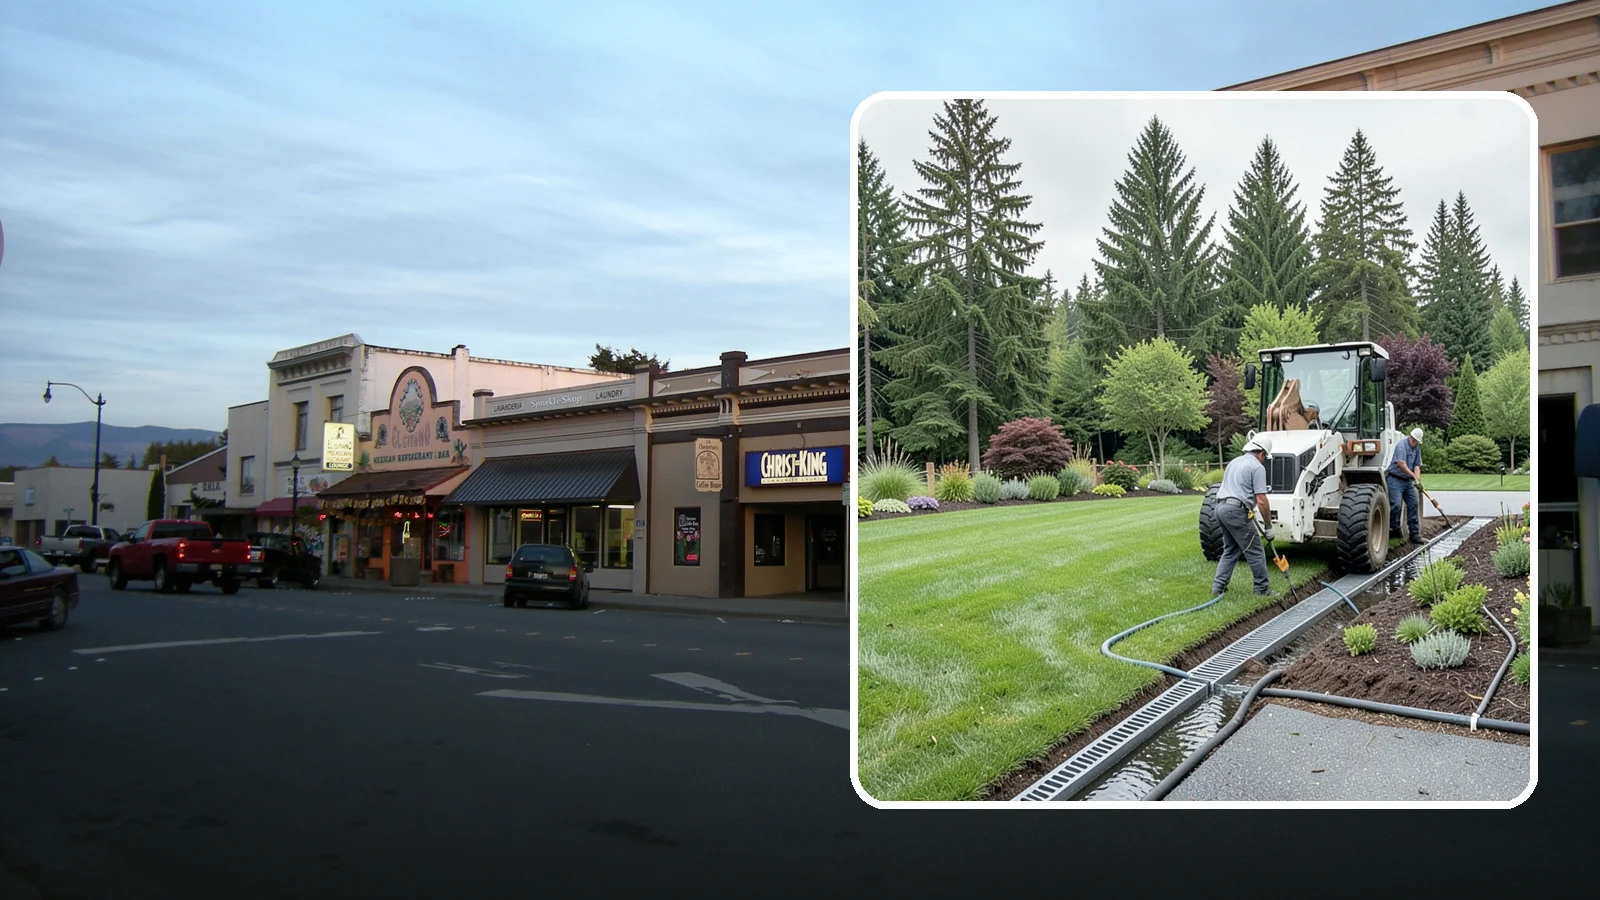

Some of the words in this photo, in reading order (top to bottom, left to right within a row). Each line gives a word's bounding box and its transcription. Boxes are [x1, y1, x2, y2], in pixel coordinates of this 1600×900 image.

[595, 389, 623, 400] LAUNDRY
[493, 402, 522, 412] LAVANDERIA
[398, 452, 433, 461] RESTAURANT
[438, 450, 449, 458] BAR
[761, 452, 797, 478] CHRIST
[799, 450, 827, 476] KING
